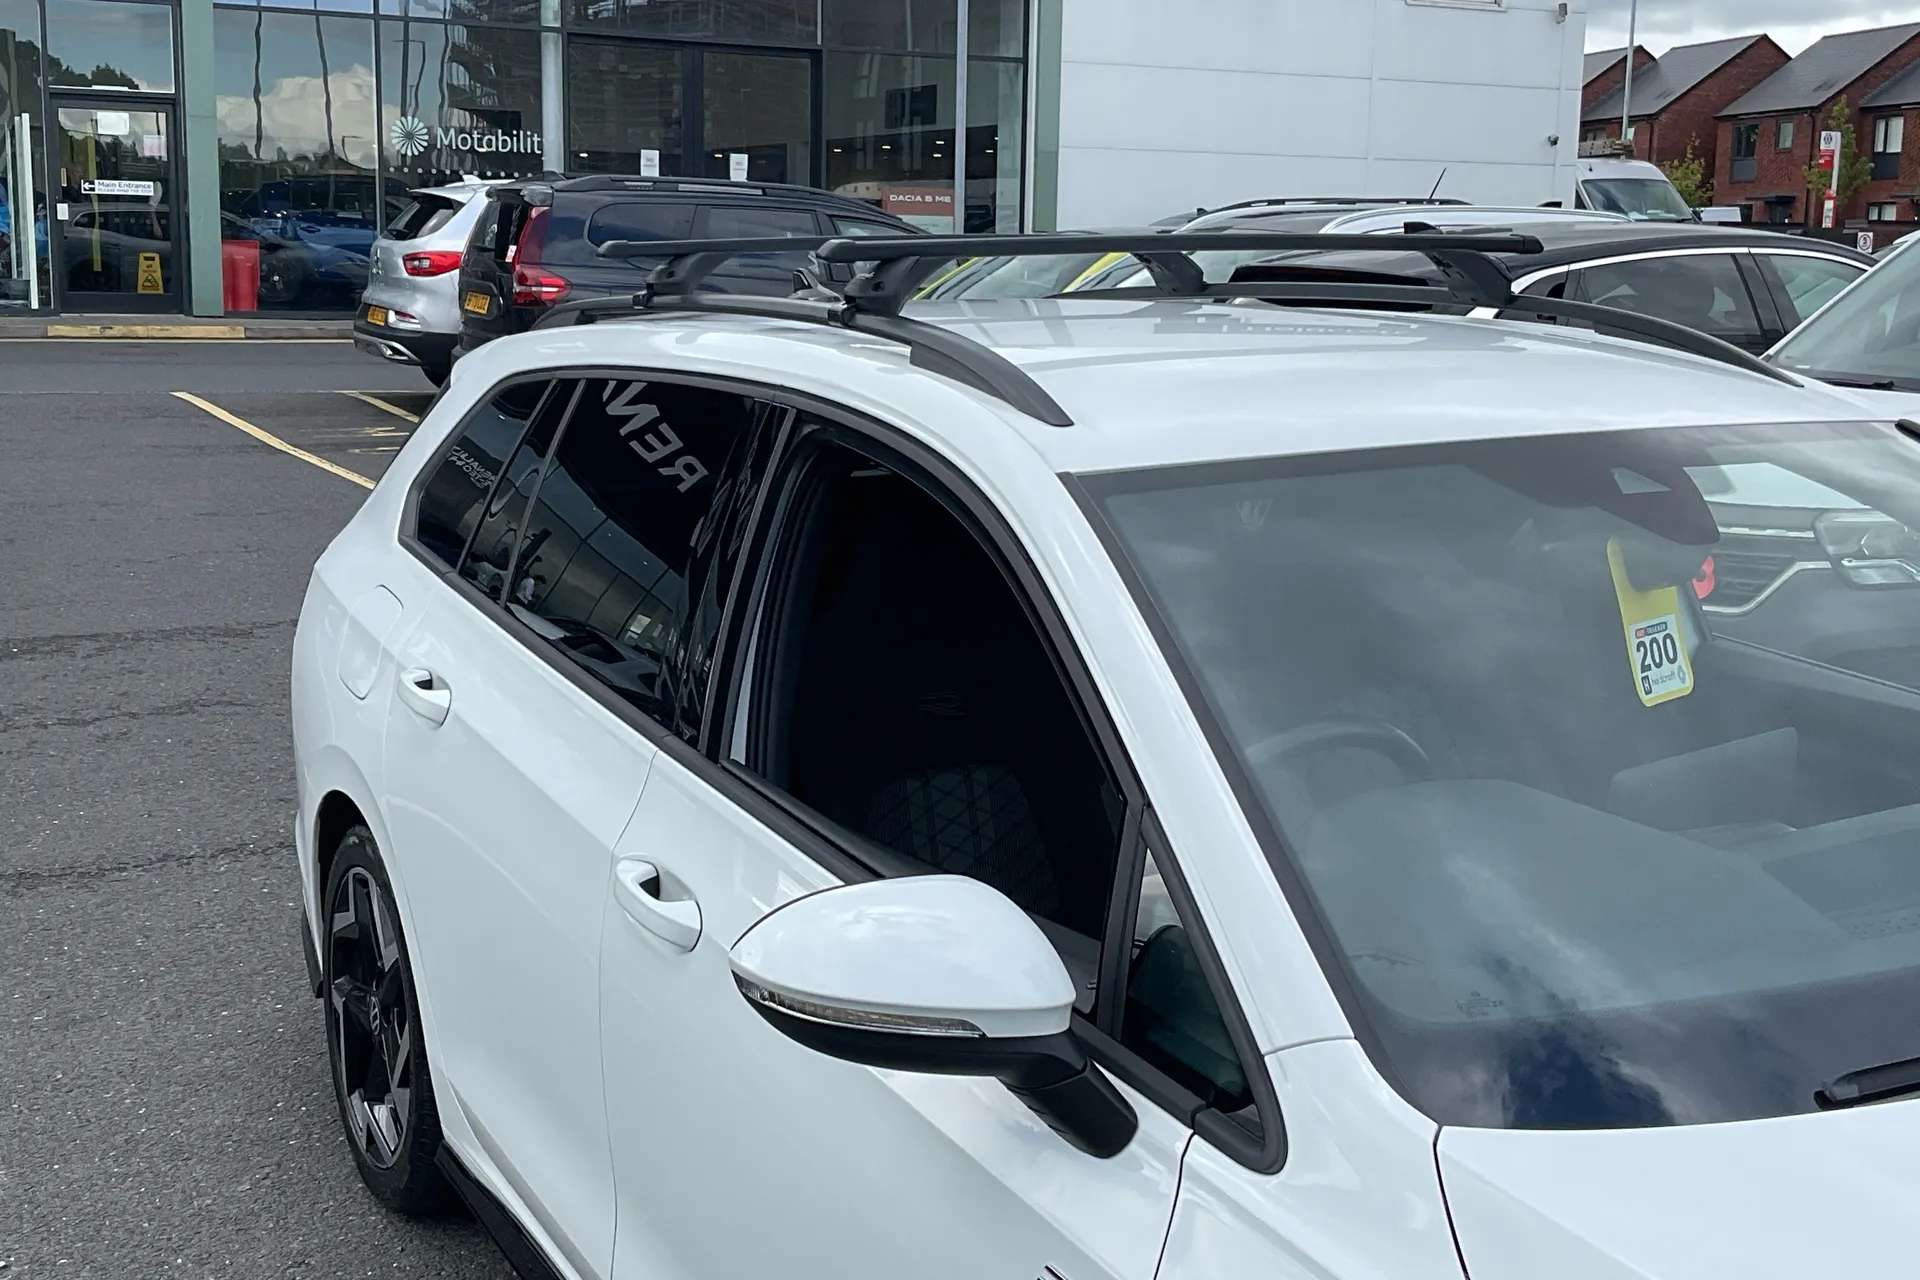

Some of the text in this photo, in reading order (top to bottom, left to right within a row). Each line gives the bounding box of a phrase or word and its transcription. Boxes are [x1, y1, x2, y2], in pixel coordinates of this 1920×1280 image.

[436, 127, 543, 157] Motabilit
[119, 181, 152, 189] Entrance
[889, 194, 922, 202] DACIA
[935, 195, 952, 203] ME
[1636, 633, 1678, 674] 200
